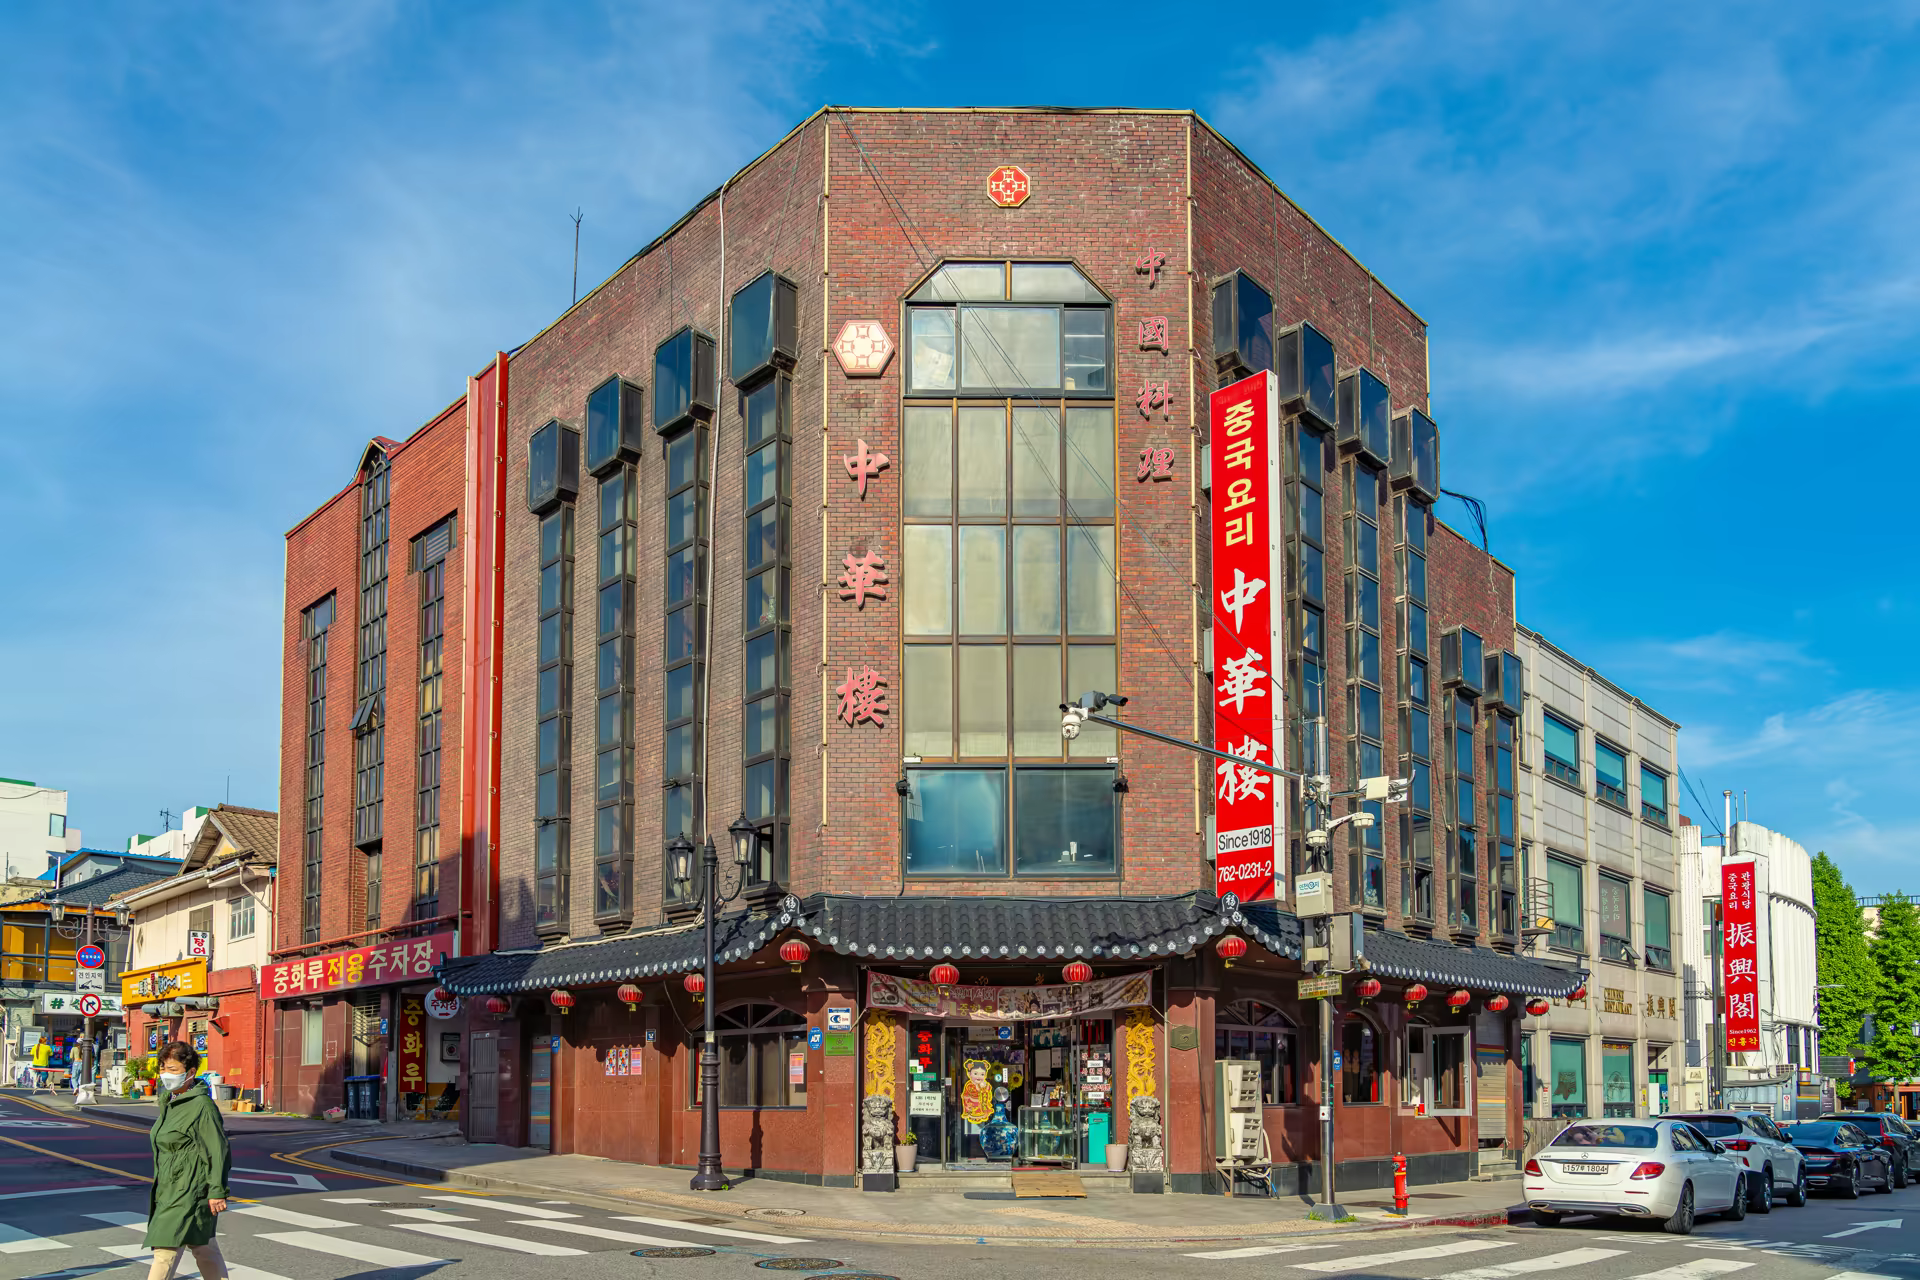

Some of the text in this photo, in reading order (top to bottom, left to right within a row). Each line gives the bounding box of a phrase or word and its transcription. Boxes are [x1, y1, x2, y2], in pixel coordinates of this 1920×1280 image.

[1135, 247, 1175, 482] 中國料理
[1223, 398, 1256, 547] 중국요리
[836, 438, 890, 729] 中華樓
[1217, 567, 1271, 806] 中華樓
[1728, 872, 1738, 910] 중국요리
[1741, 871, 1752, 910] 관광식당
[193, 938, 206, 955] 장어
[273, 940, 434, 994] 중화루 전용 주차장
[1725, 921, 1756, 1019] 振興閣
[402, 998, 424, 1090] 중화루
[810, 1034, 821, 1043] ADT
[1728, 1036, 1758, 1047] 진흥각
[1587, 1165, 1605, 1173] 1804
